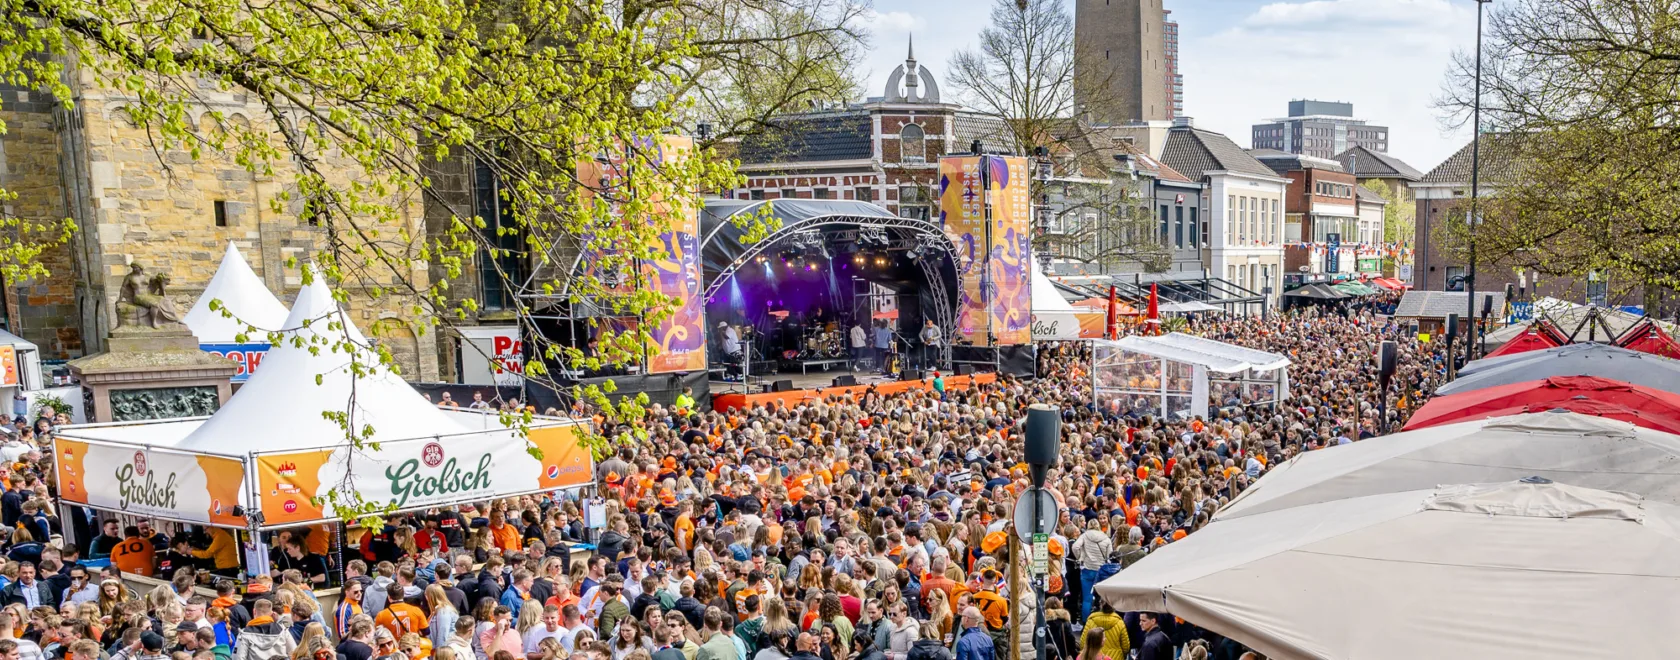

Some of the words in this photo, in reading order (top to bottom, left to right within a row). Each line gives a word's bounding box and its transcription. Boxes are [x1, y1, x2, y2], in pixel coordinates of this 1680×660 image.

[963, 164, 971, 225] ENSCHEDE
[972, 163, 982, 280] KONINGSFESTIVAL
[1010, 164, 1019, 225] ENSCHEDE
[1018, 164, 1028, 278] KONINGSFESTIVAL
[1512, 304, 1533, 318] WC
[115, 463, 177, 510] Grolsch
[385, 453, 492, 508] Grolsch
[119, 542, 145, 556] 10
